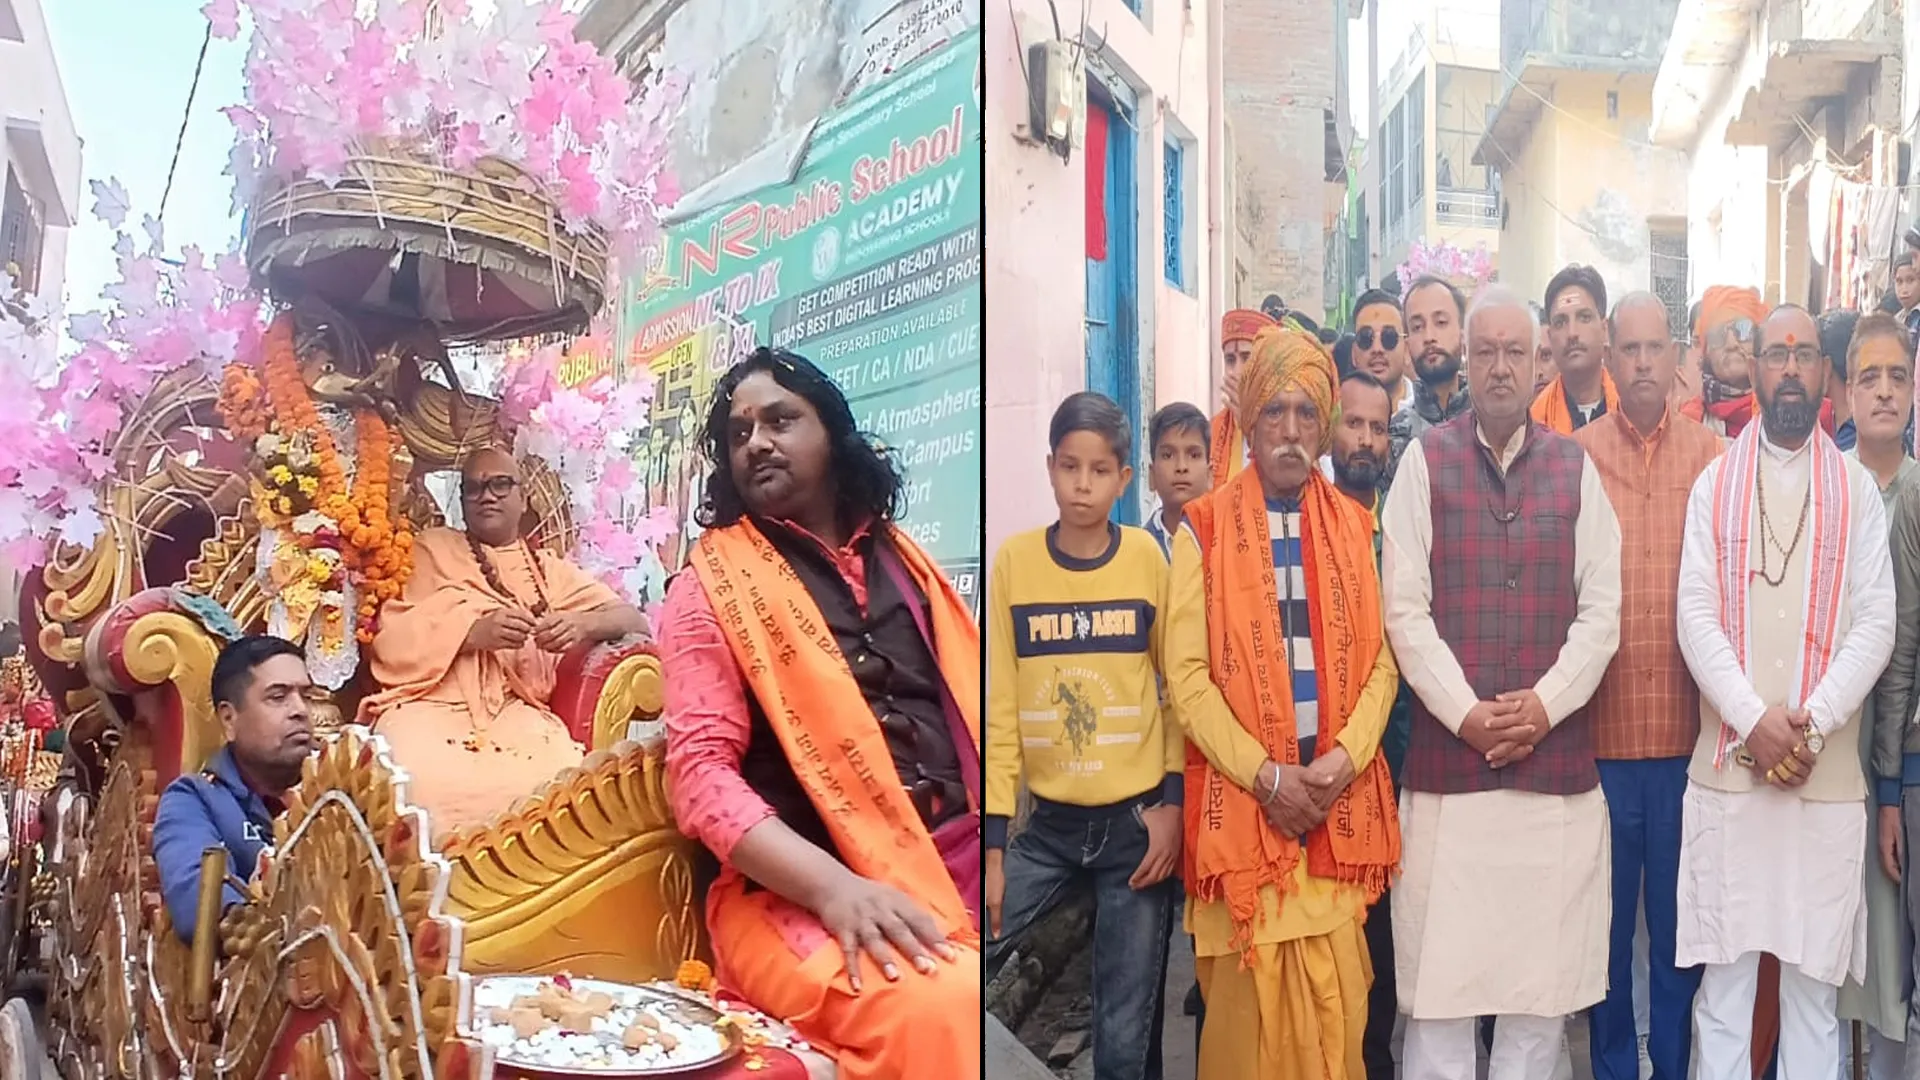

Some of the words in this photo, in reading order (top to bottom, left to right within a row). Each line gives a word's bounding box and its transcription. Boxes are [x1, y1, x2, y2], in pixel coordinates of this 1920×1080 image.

[765, 177, 842, 248] Public
[850, 105, 964, 203] School
[848, 168, 964, 243] ACADEMY
[798, 295, 818, 315] GET
[820, 263, 896, 306] COMPETITION
[898, 248, 939, 278] READY
[942, 228, 976, 261] WITH
[641, 310, 695, 350] ADMISSION
[772, 321, 804, 348] INDIA'S
[807, 311, 836, 336] BEST
[835, 299, 878, 328] DIGITAL
[881, 272, 943, 310] LEARNING
[820, 323, 899, 361] PREPARATION
[901, 299, 967, 337] AVAILABLE
[670, 341, 693, 367] OPEN
[871, 355, 891, 384] CA
[904, 339, 935, 373] NDA
[875, 385, 980, 436] Atmosphere
[902, 430, 975, 467] Campus
[1027, 613, 1074, 642] POLO
